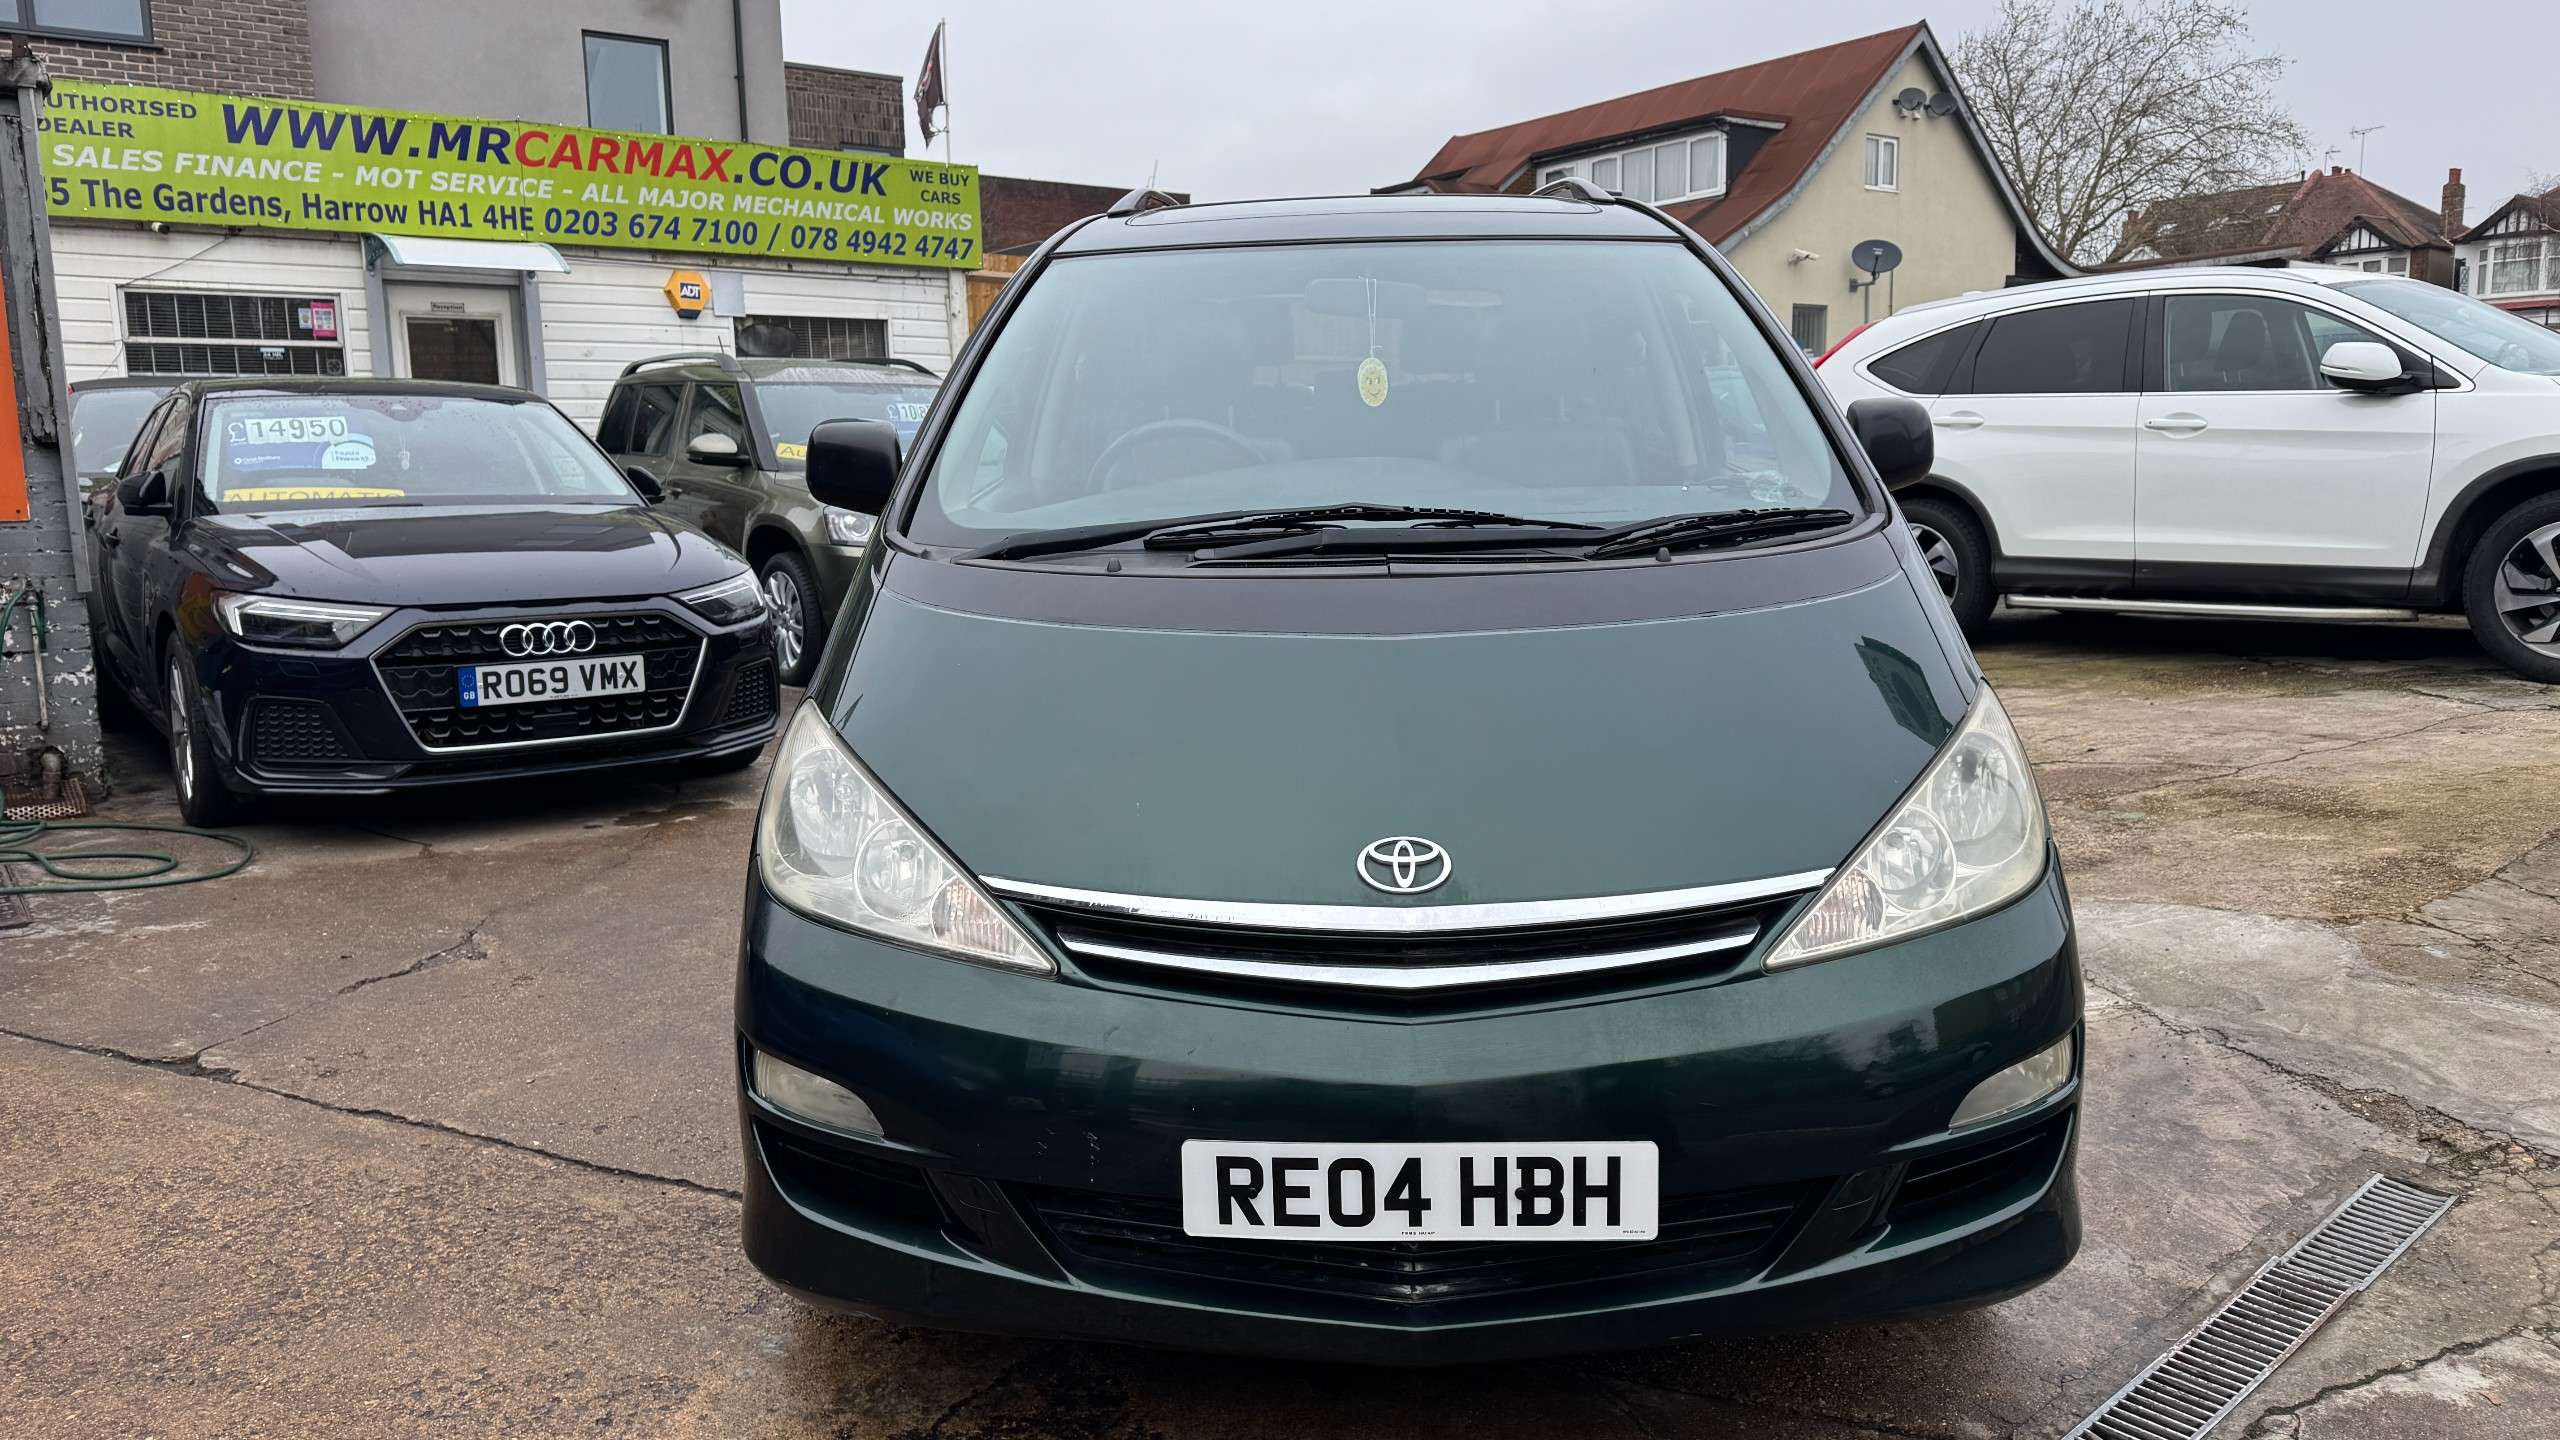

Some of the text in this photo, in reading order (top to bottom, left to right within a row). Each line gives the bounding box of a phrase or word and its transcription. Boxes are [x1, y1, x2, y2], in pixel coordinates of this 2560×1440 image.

[43, 93, 196, 118] UTHORISED
[39, 117, 135, 138] DEALER
[222, 104, 890, 197] WWW.MRCARMAX.CO.UK
[52, 144, 163, 172] SALES
[175, 152, 322, 183] FINANCE
[355, 165, 422, 189] MOT
[430, 171, 554, 199] SERVICE
[581, 182, 629, 205] ALL
[638, 186, 725, 213] MAJOR
[733, 193, 885, 224] MECHANICAL
[893, 207, 972, 231] WORKS
[910, 169, 969, 187] WE BUY
[921, 190, 961, 204] CARS
[44, 177, 974, 260] 5 The Gardens, Harrow HA1 4HE 0203 674 7100 / 078 4942 4747
[681, 284, 699, 298] ADT
[227, 418, 346, 445] £14950
[482, 660, 639, 699] RO69 VMX
[463, 691, 476, 700] GB
[1216, 1156, 1622, 1228] RE04 HBH
